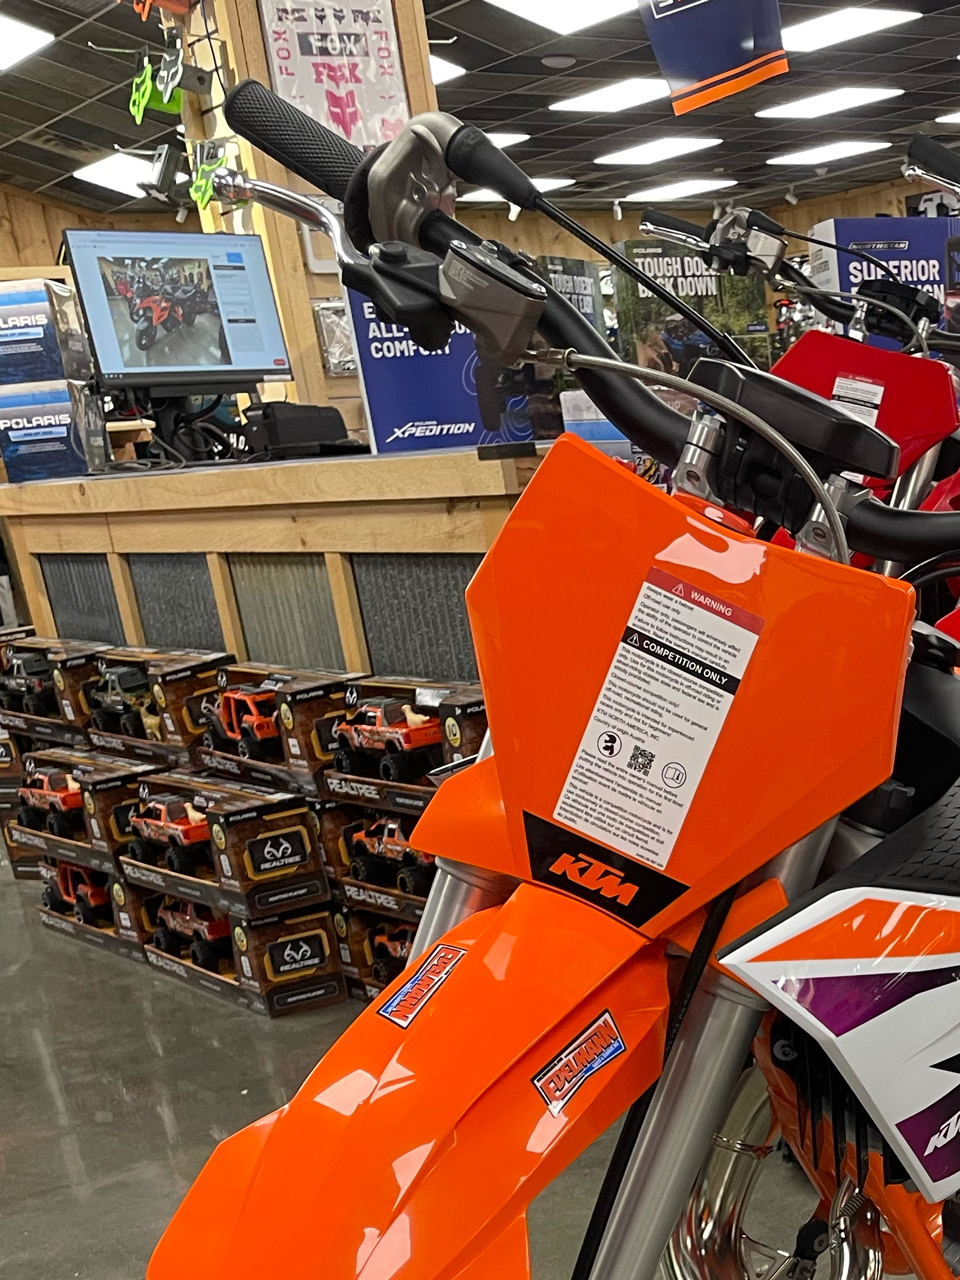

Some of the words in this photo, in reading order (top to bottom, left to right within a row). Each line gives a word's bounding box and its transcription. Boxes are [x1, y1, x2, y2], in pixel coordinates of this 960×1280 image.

[272, 29, 295, 77] FOX
[308, 35, 357, 55] FOX
[374, 31, 394, 76] FOX
[634, 257, 682, 277] TOUGH
[848, 260, 940, 283] SUPERIOR
[638, 277, 676, 298] BCK
[677, 276, 717, 297] DOWN
[0, 314, 48, 328] LARIS
[0, 414, 71, 430] POLARIS
[385, 422, 475, 443] XPEDITION
[690, 590, 733, 617] WARNING
[643, 640, 702, 674] COMPETITION
[704, 664, 728, 686] ONLY
[326, 778, 381, 799] REALTREE
[260, 855, 302, 870] REALTREE
[549, 853, 640, 906] KTM
[344, 885, 399, 909] REALTREE
[279, 957, 320, 972] REALTREE
[540, 1018, 619, 1101] EDELMANN
